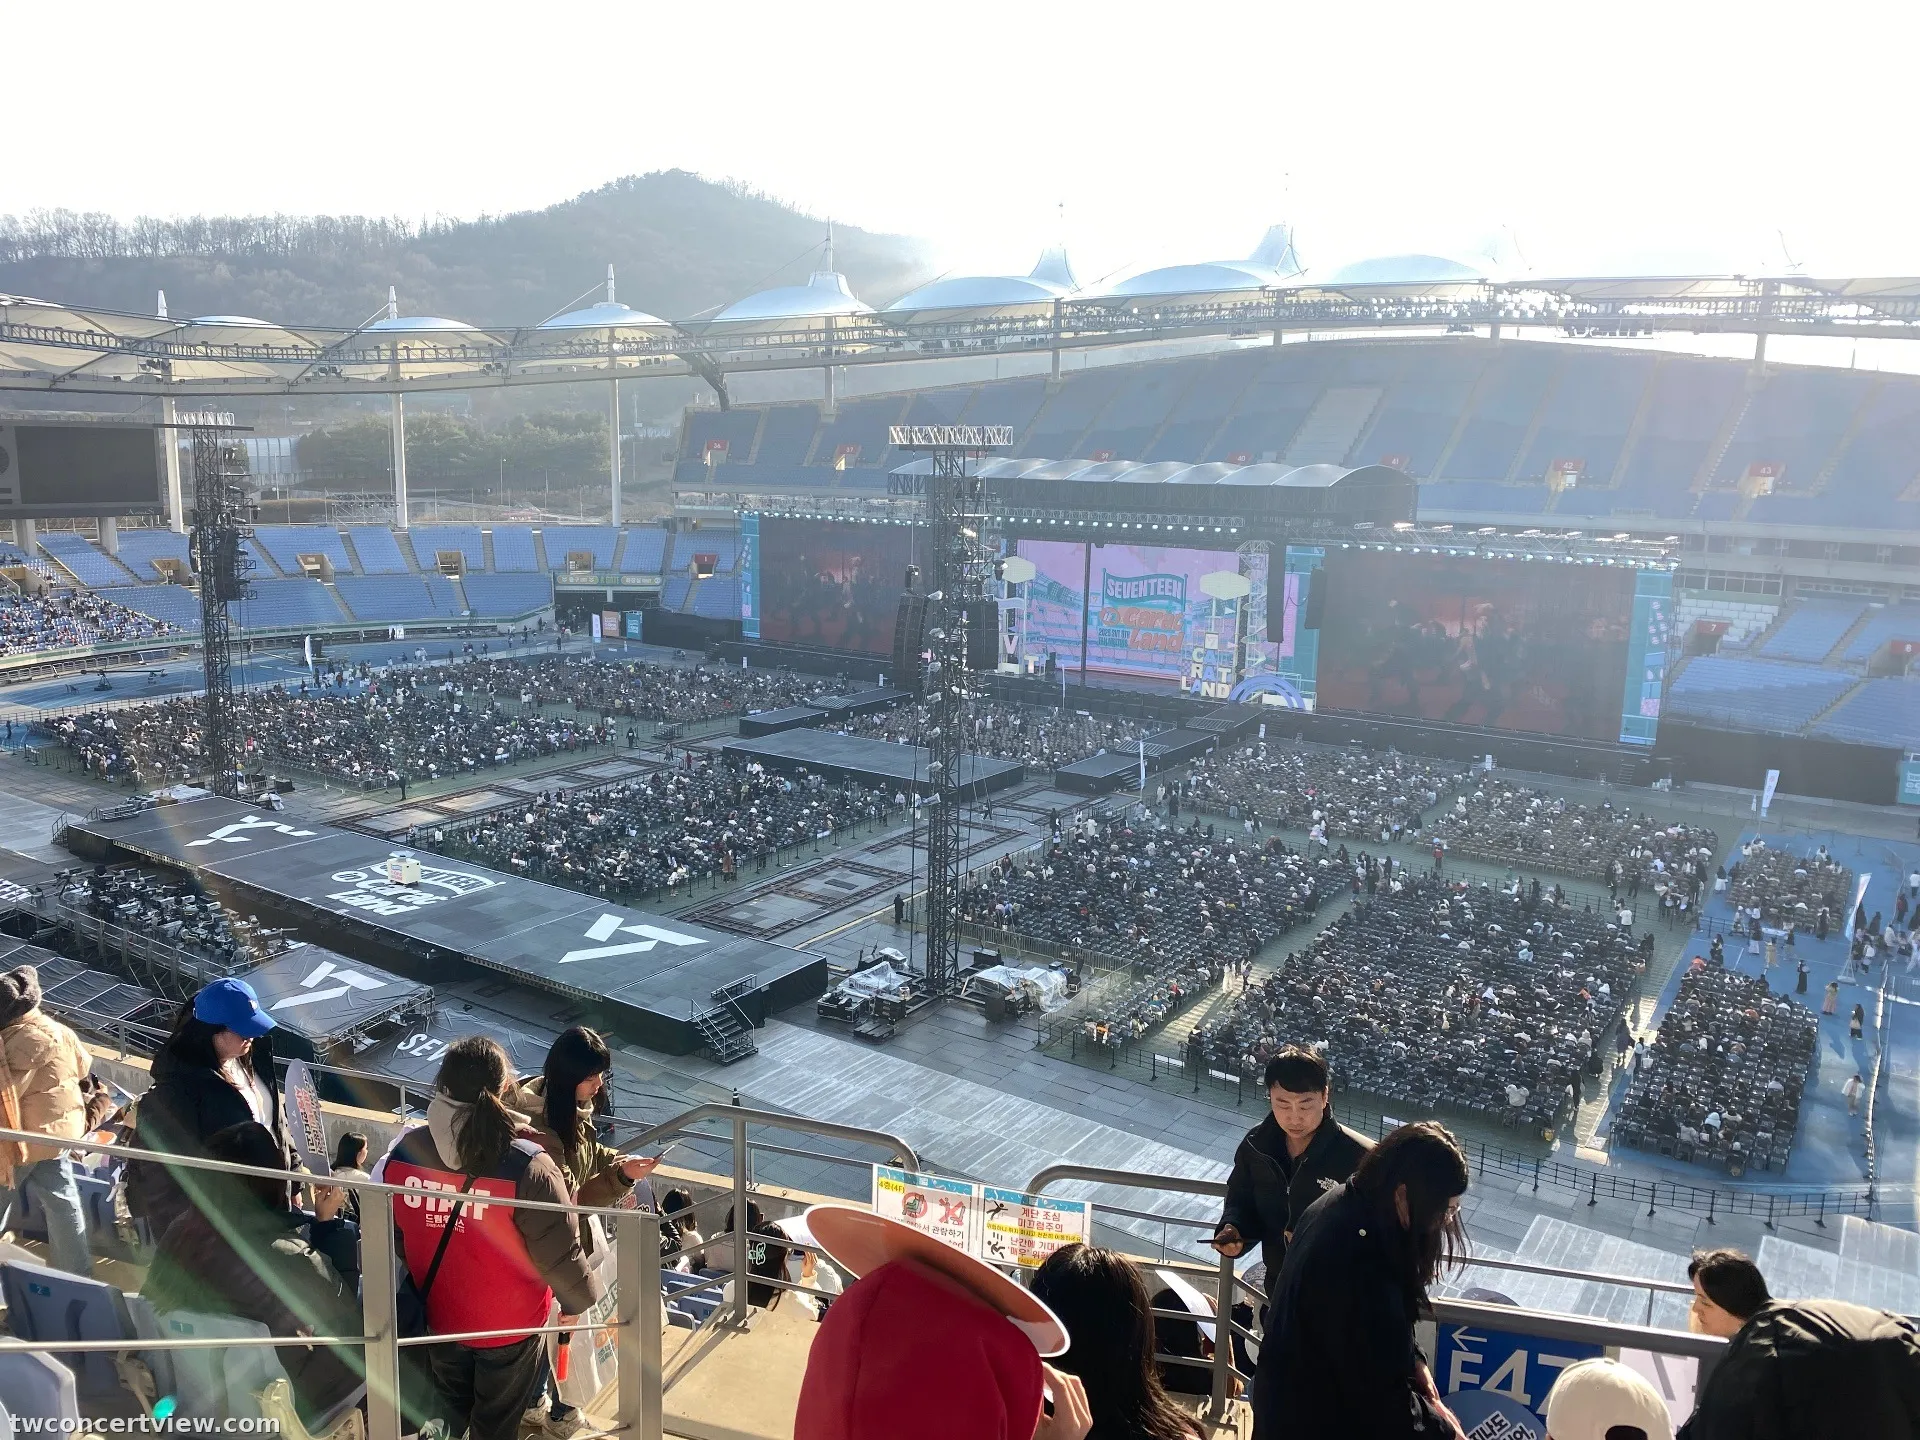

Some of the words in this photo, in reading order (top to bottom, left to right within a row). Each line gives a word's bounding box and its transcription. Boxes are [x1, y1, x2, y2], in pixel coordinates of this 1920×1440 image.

[1563, 462, 1574, 470] 42
[1760, 466, 1772, 475] 43
[1106, 578, 1182, 600] SEVENTEEN
[1120, 606, 1185, 631] Carat
[1127, 628, 1185, 653] Land
[1181, 675, 1231, 699] LAND
[1021, 1207, 1039, 1219] 계단
[1042, 1211, 1061, 1222] 조심
[932, 1225, 964, 1239] 관람하기
[1017, 1218, 1063, 1233] 미끄럼주의
[1010, 1236, 1035, 1248] 난간에
